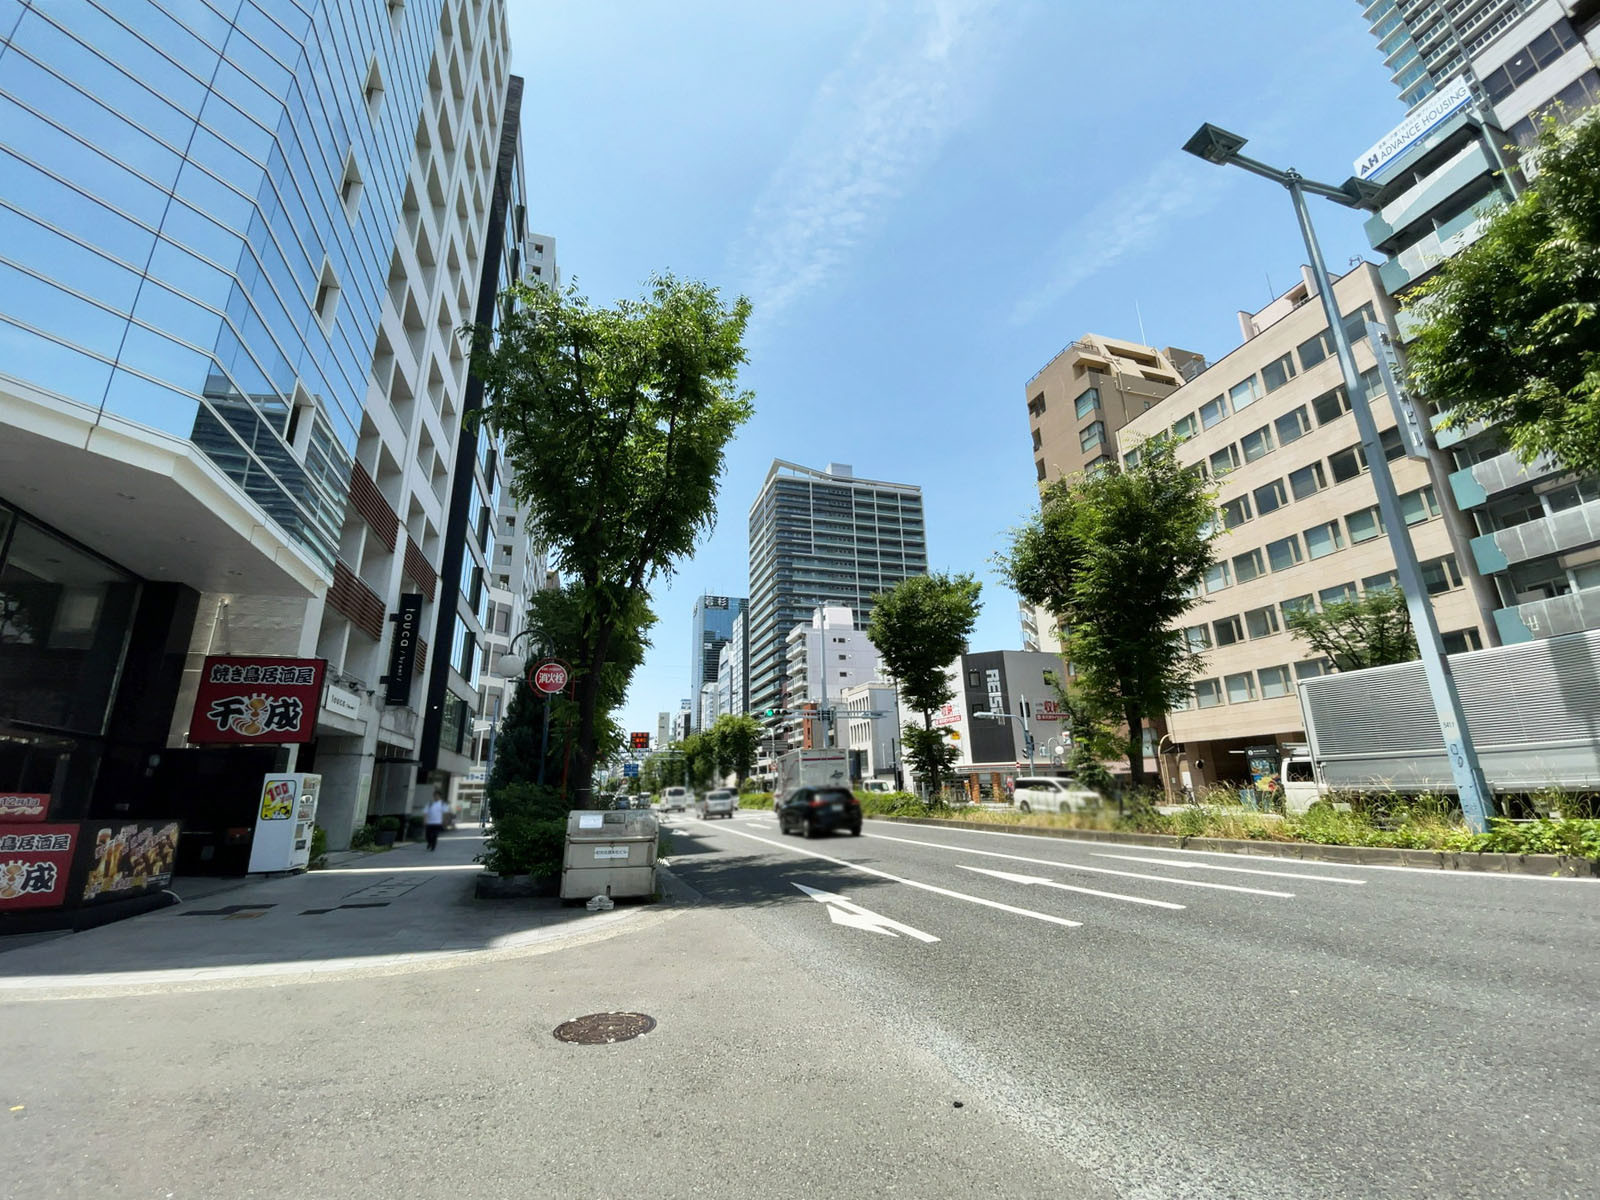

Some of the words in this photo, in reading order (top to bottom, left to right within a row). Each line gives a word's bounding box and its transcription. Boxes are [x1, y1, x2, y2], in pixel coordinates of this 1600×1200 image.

[1381, 122, 1422, 160] ADVANCE
[1421, 86, 1467, 126] HOUSING
[210, 664, 316, 685] 焼き鳥居酒屋
[539, 672, 565, 683] 消火栓
